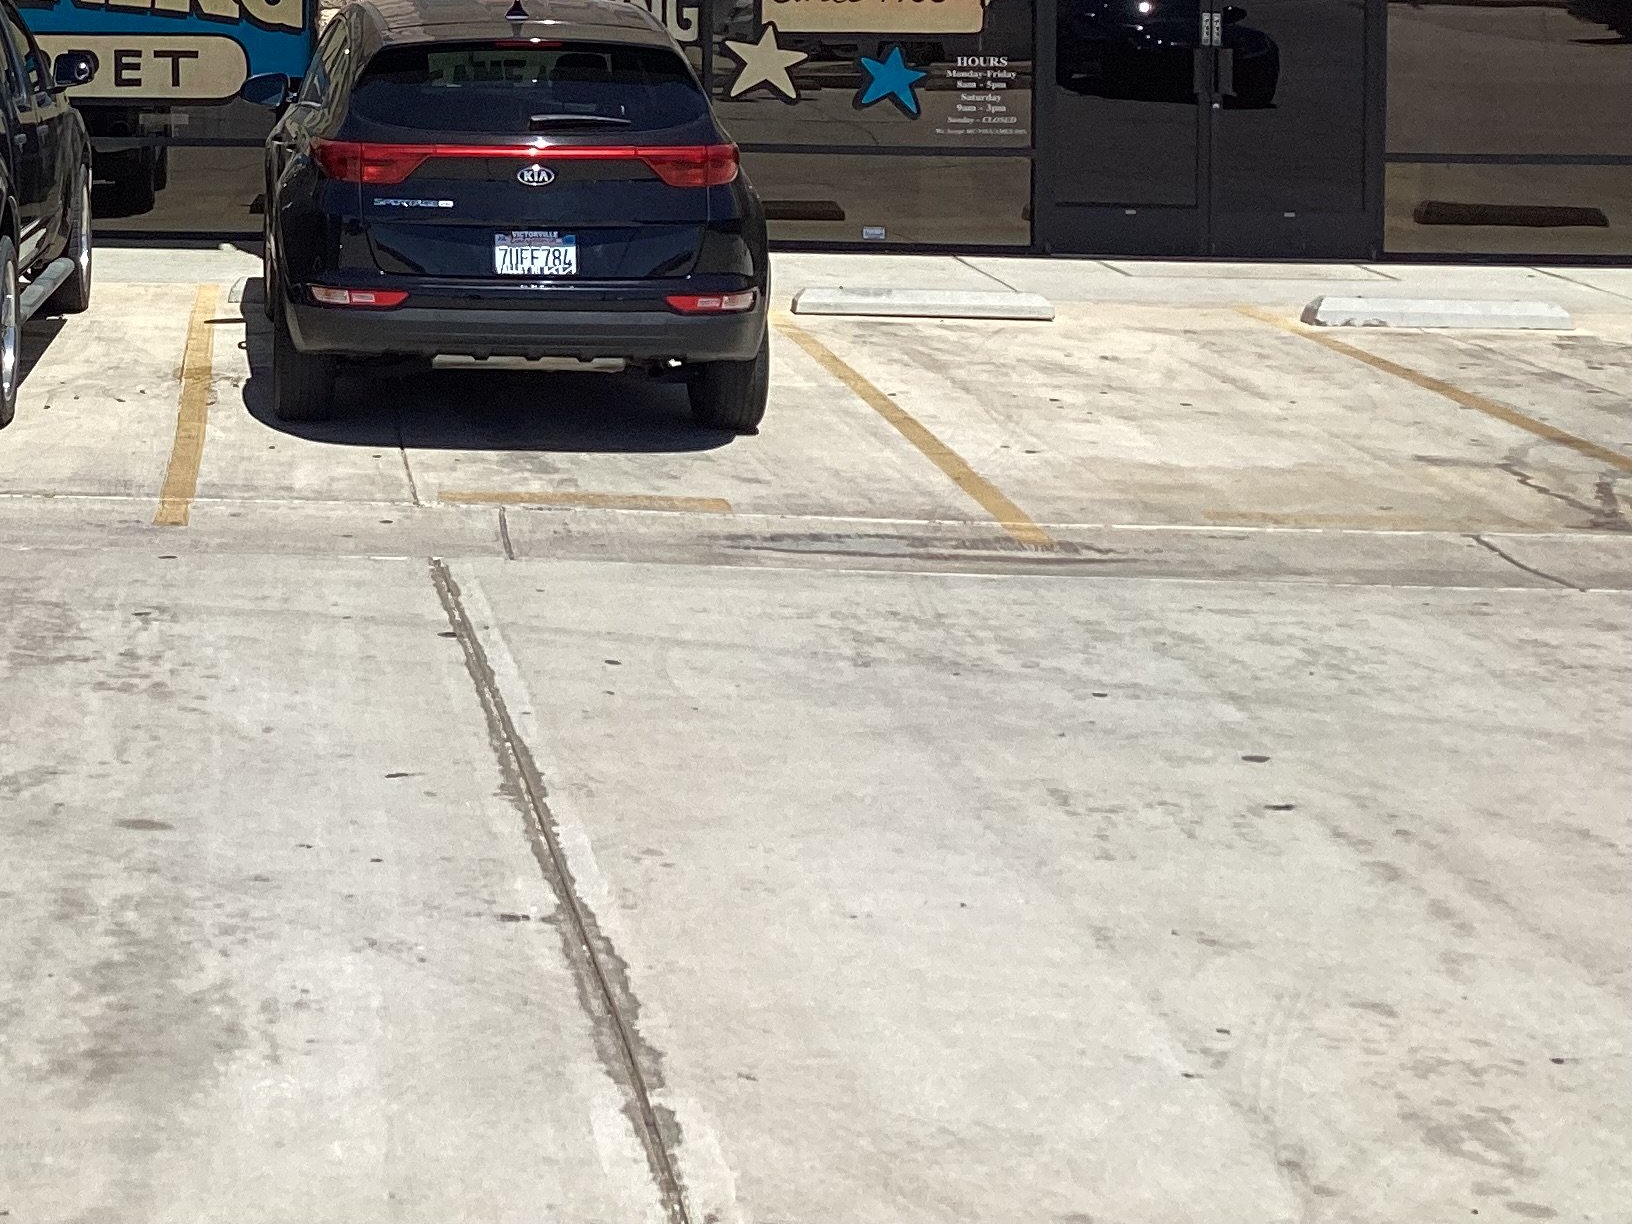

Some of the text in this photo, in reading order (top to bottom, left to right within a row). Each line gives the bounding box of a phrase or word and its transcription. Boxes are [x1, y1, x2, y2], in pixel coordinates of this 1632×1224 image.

[956, 56, 1008, 67] HOURS
[960, 93, 1001, 103] Saturday
[523, 170, 549, 182] KIA
